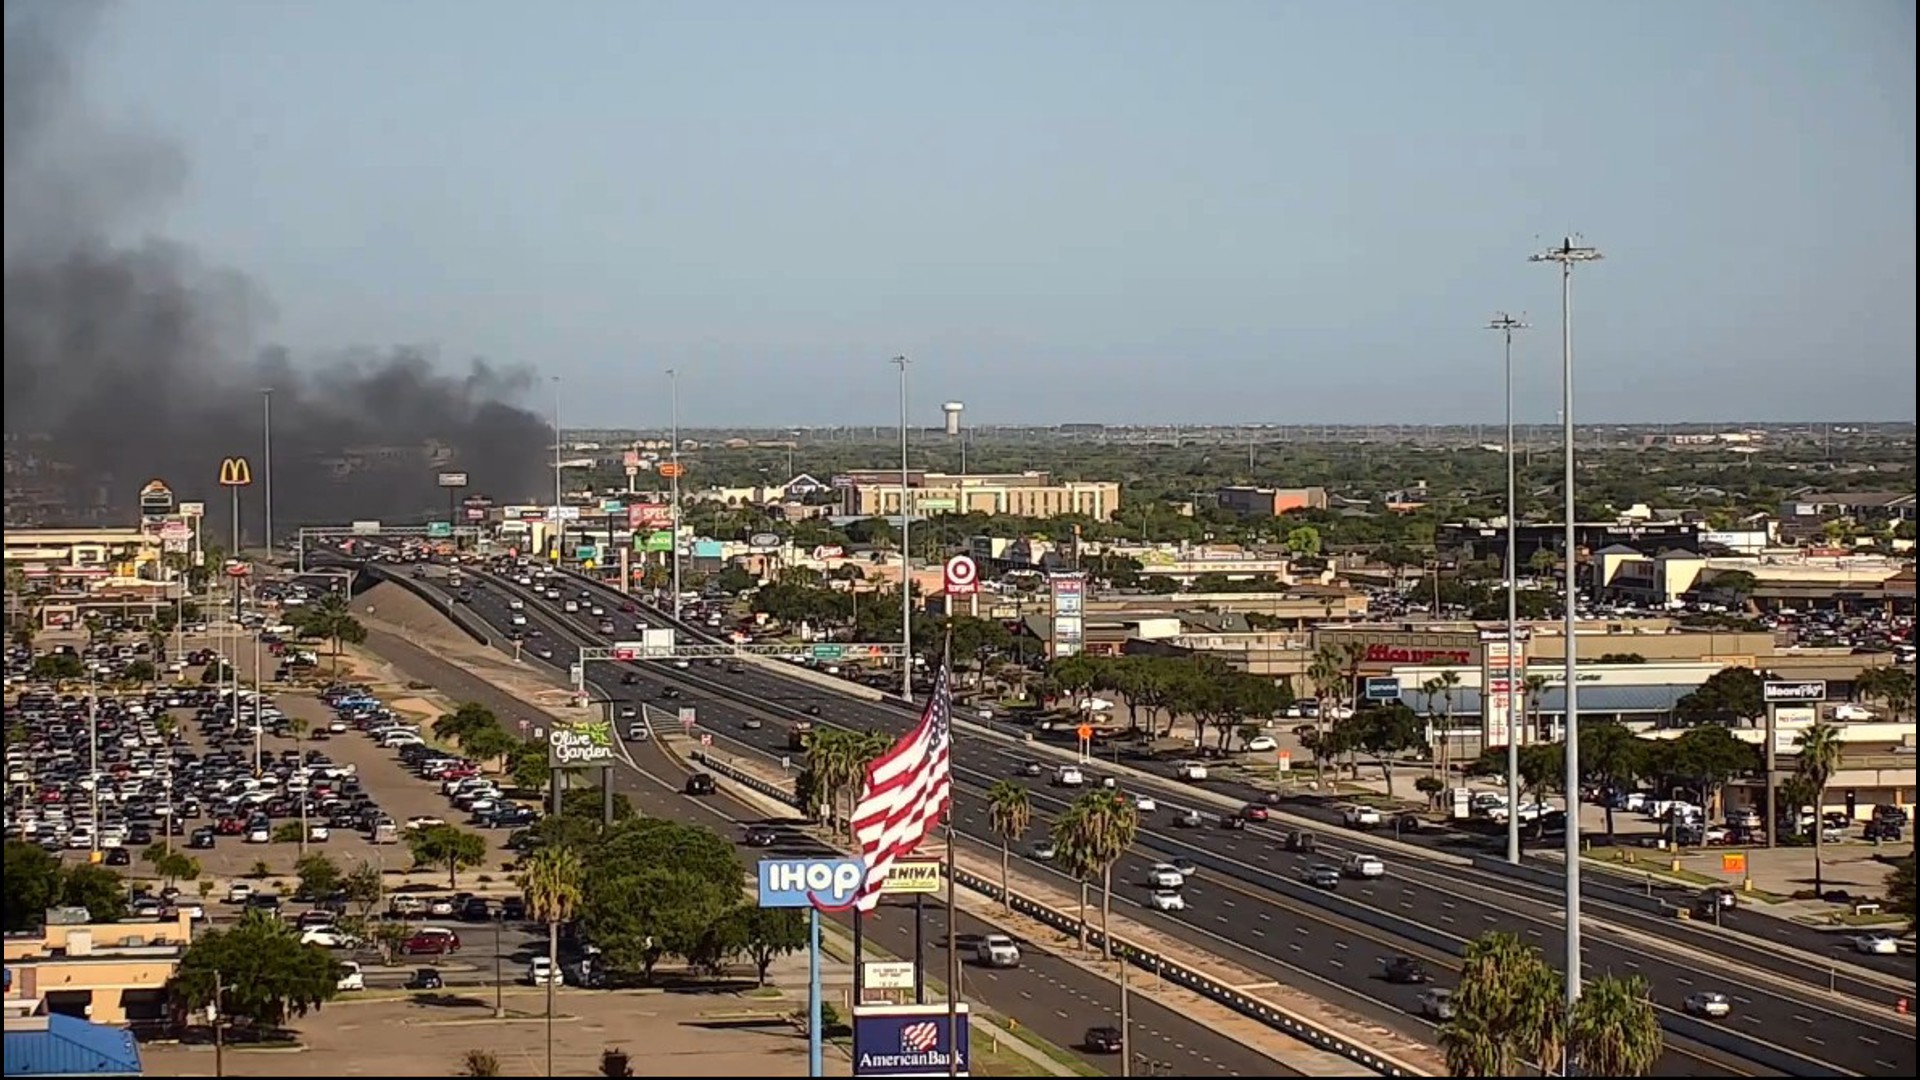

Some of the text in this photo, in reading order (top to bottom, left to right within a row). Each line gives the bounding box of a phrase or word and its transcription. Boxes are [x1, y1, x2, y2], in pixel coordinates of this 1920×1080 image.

[550, 730, 591, 746] Olive
[556, 744, 614, 763] Garden
[769, 862, 861, 899] IHOP
[888, 866, 937, 880] ENIWA
